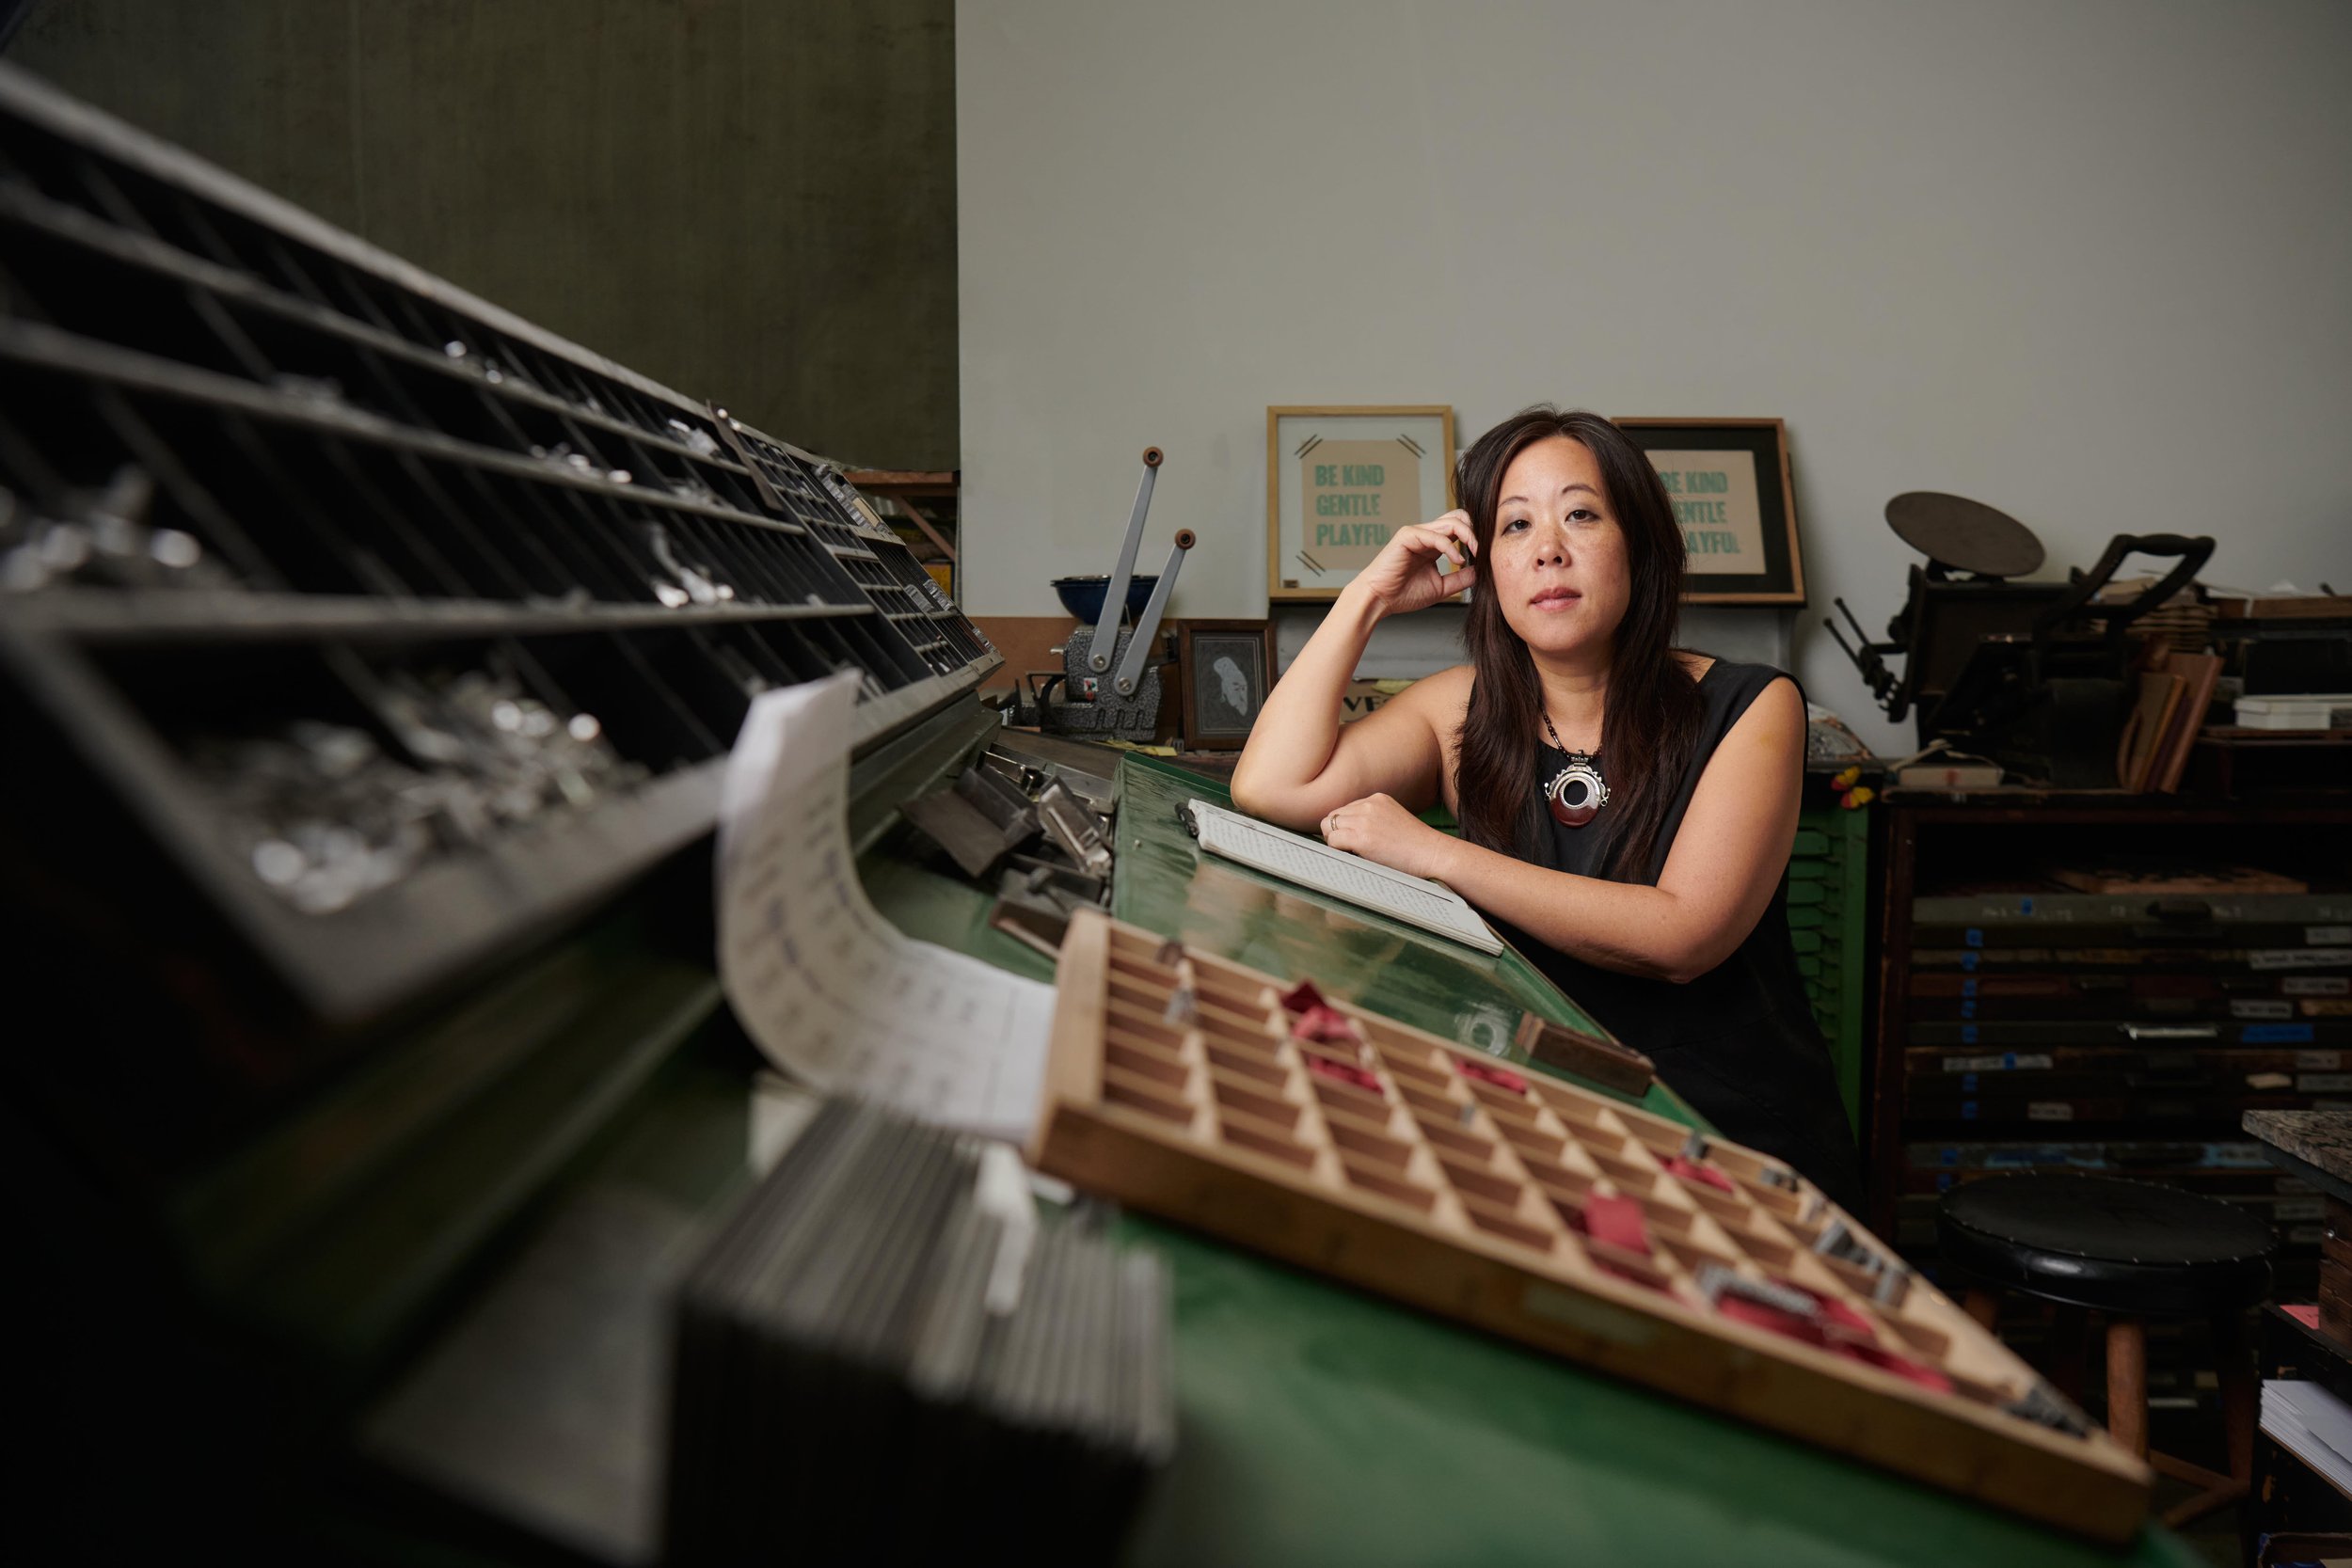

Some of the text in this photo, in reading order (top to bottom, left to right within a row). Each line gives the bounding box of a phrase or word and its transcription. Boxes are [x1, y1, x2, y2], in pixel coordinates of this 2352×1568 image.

[1315, 465, 1385, 486] BE KIND
[1686, 471, 1728, 494] KIND
[1315, 494, 1380, 516] GENTLE
[1672, 500, 1727, 523] ENTLE
